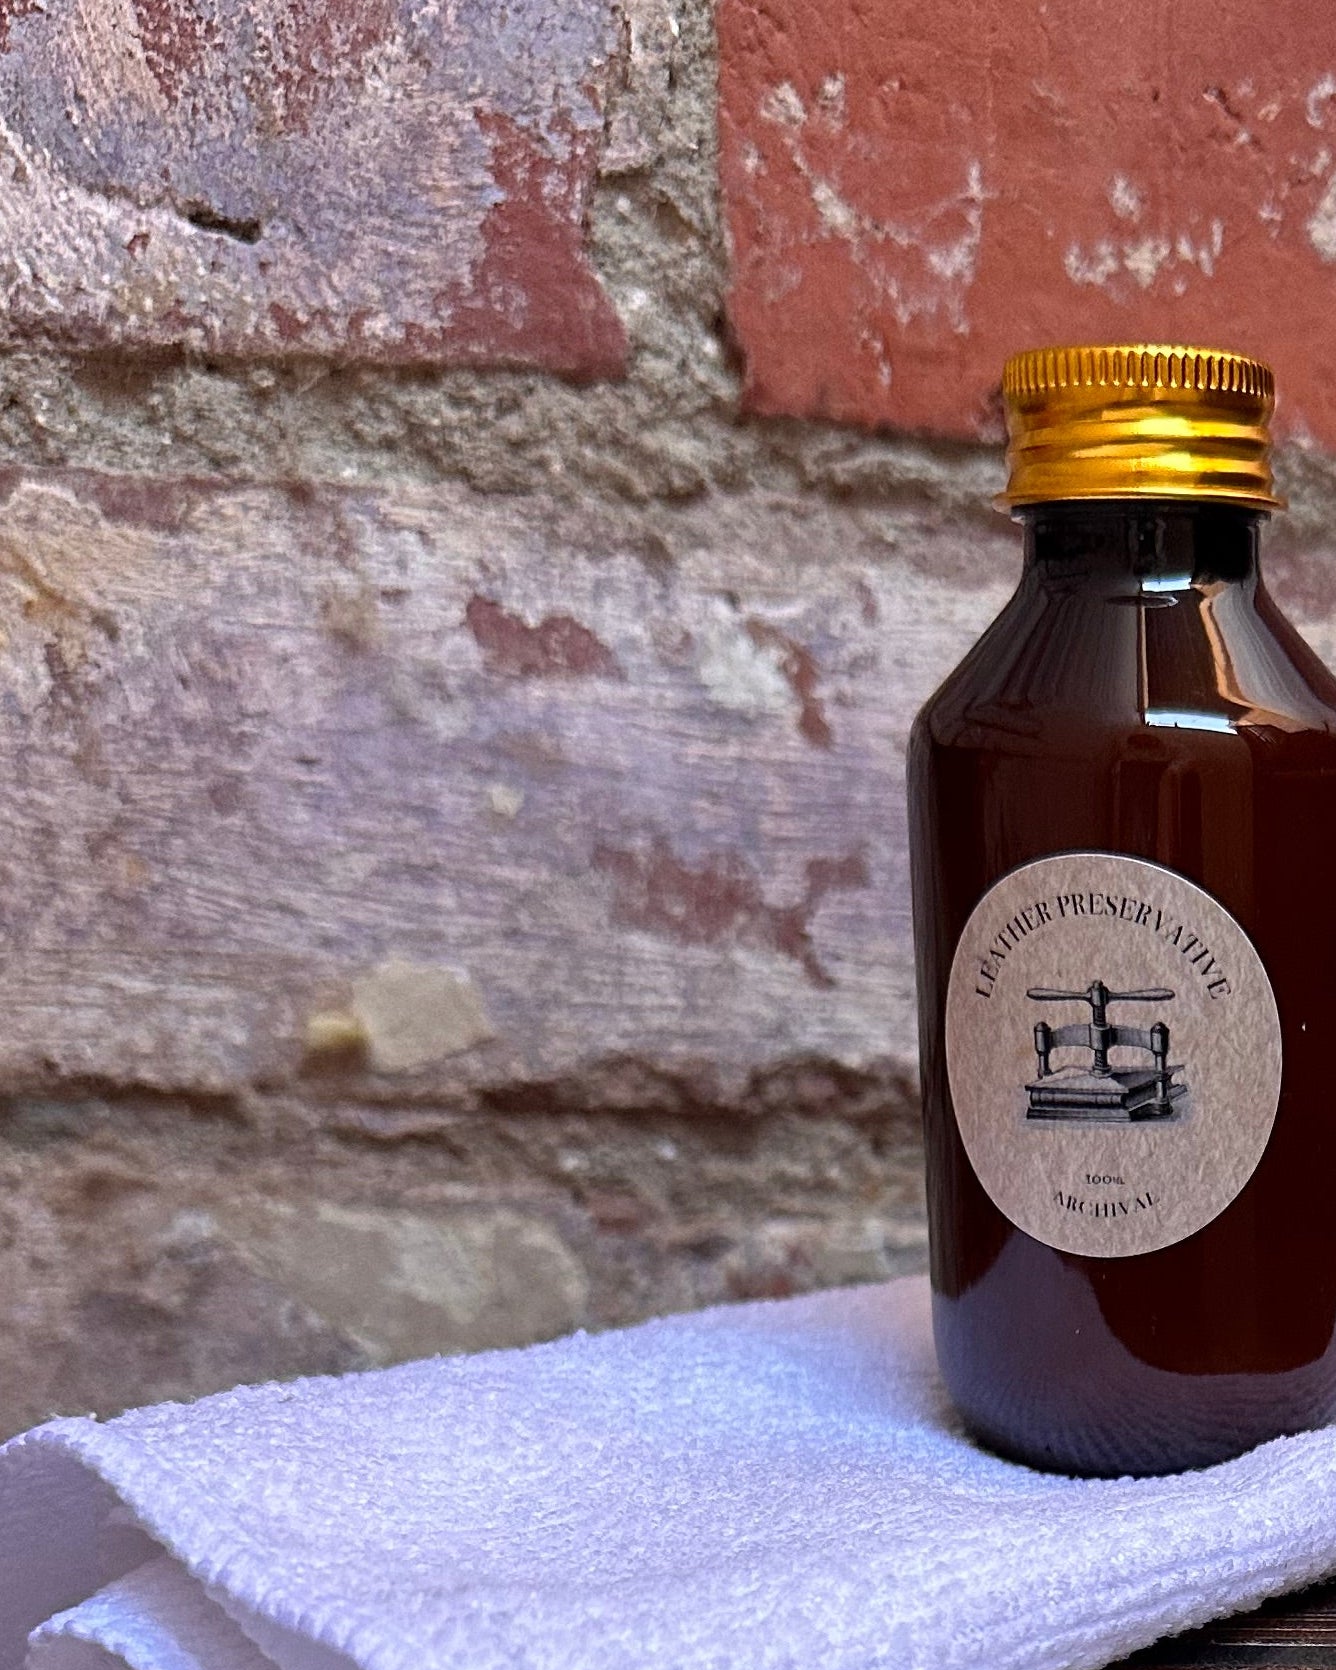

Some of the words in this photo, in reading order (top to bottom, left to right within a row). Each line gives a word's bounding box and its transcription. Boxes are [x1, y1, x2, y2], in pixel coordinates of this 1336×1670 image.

[975, 901, 1053, 999] LEATHER
[1056, 892, 1232, 1000] PRESERVATIVE
[1053, 1190, 1161, 1218] ARCHIVAL
